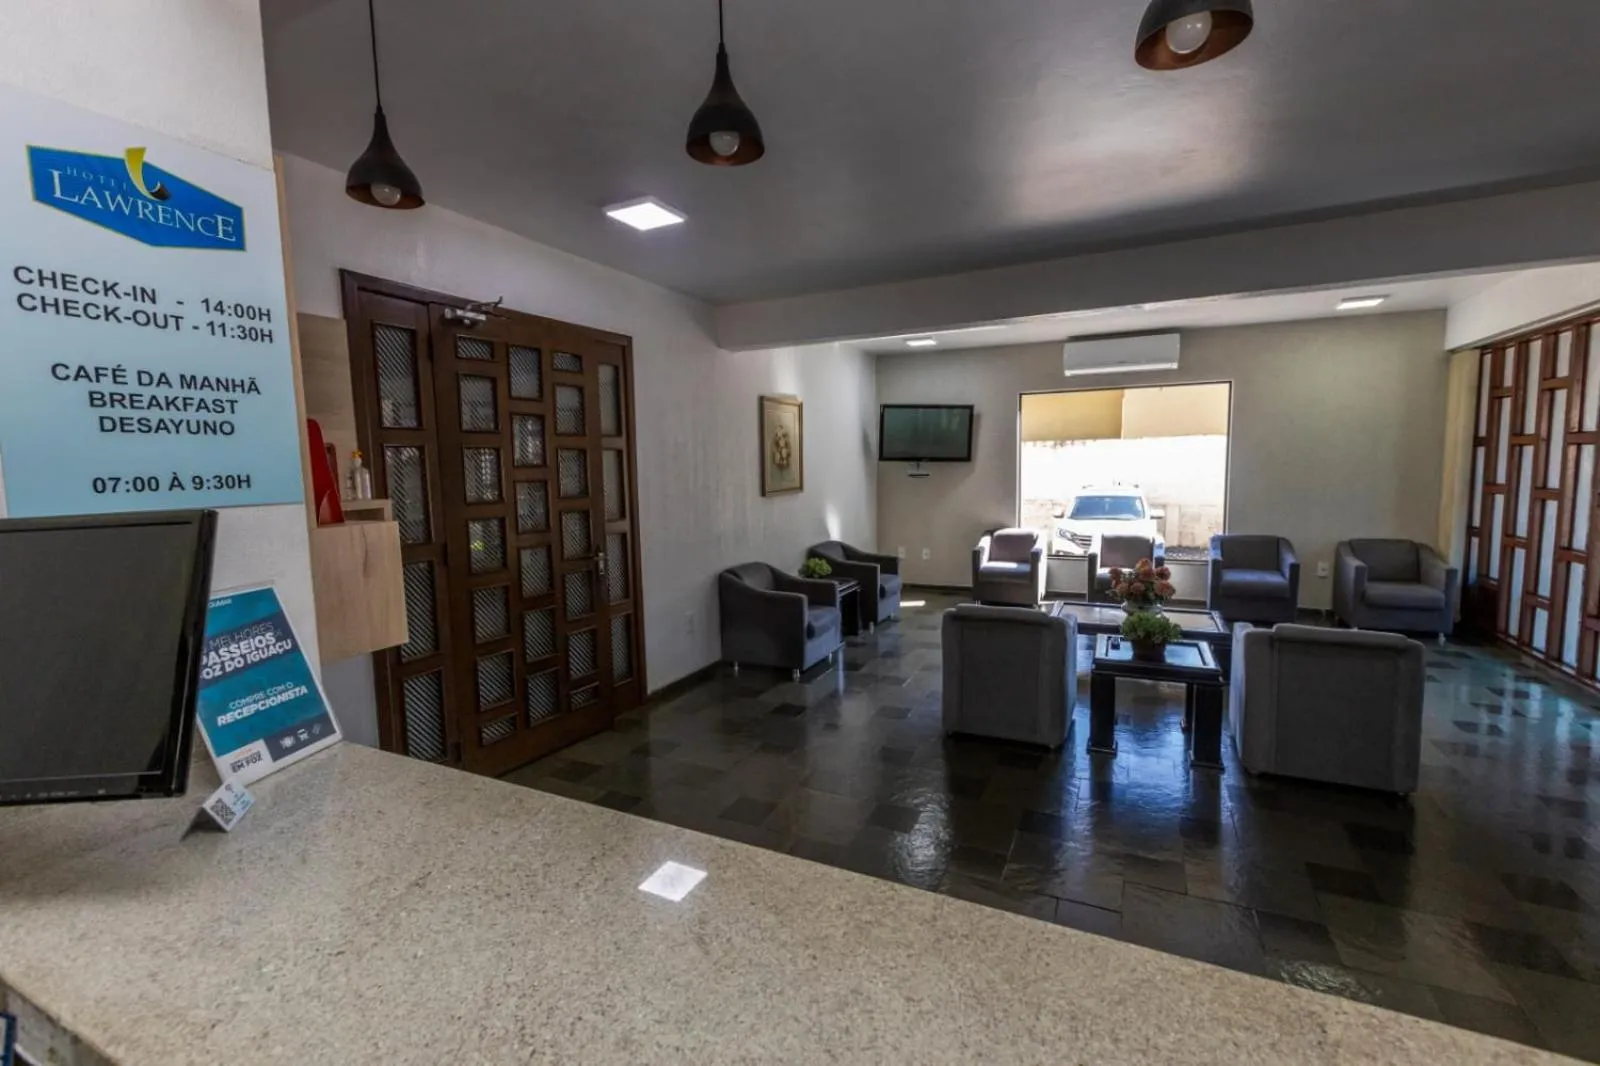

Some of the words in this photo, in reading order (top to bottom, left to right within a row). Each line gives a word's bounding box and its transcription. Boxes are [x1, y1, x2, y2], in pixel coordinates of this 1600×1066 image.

[48, 168, 236, 242] LAWRENCE
[13, 265, 158, 306] CHECK-IN
[200, 297, 272, 324] 14:00H
[16, 292, 184, 332] CHECK-OUT
[205, 320, 274, 345] 11:30H
[50, 362, 129, 386] CAFÉ
[136, 369, 174, 389] DA
[178, 373, 262, 396] MANHÃ
[87, 389, 239, 415] BREAKFAST
[98, 415, 236, 437] DESAYUNO
[91, 475, 160, 495] 07:00
[167, 471, 186, 492] À
[190, 473, 252, 492] 9:30H
[200, 664, 223, 679] OZ
[224, 657, 245, 672] DO
[246, 639, 292, 664] IGUAÇU
[216, 685, 309, 727] RECEPCIONISTA
[266, 684, 285, 696] COM
[286, 681, 294, 689] O
